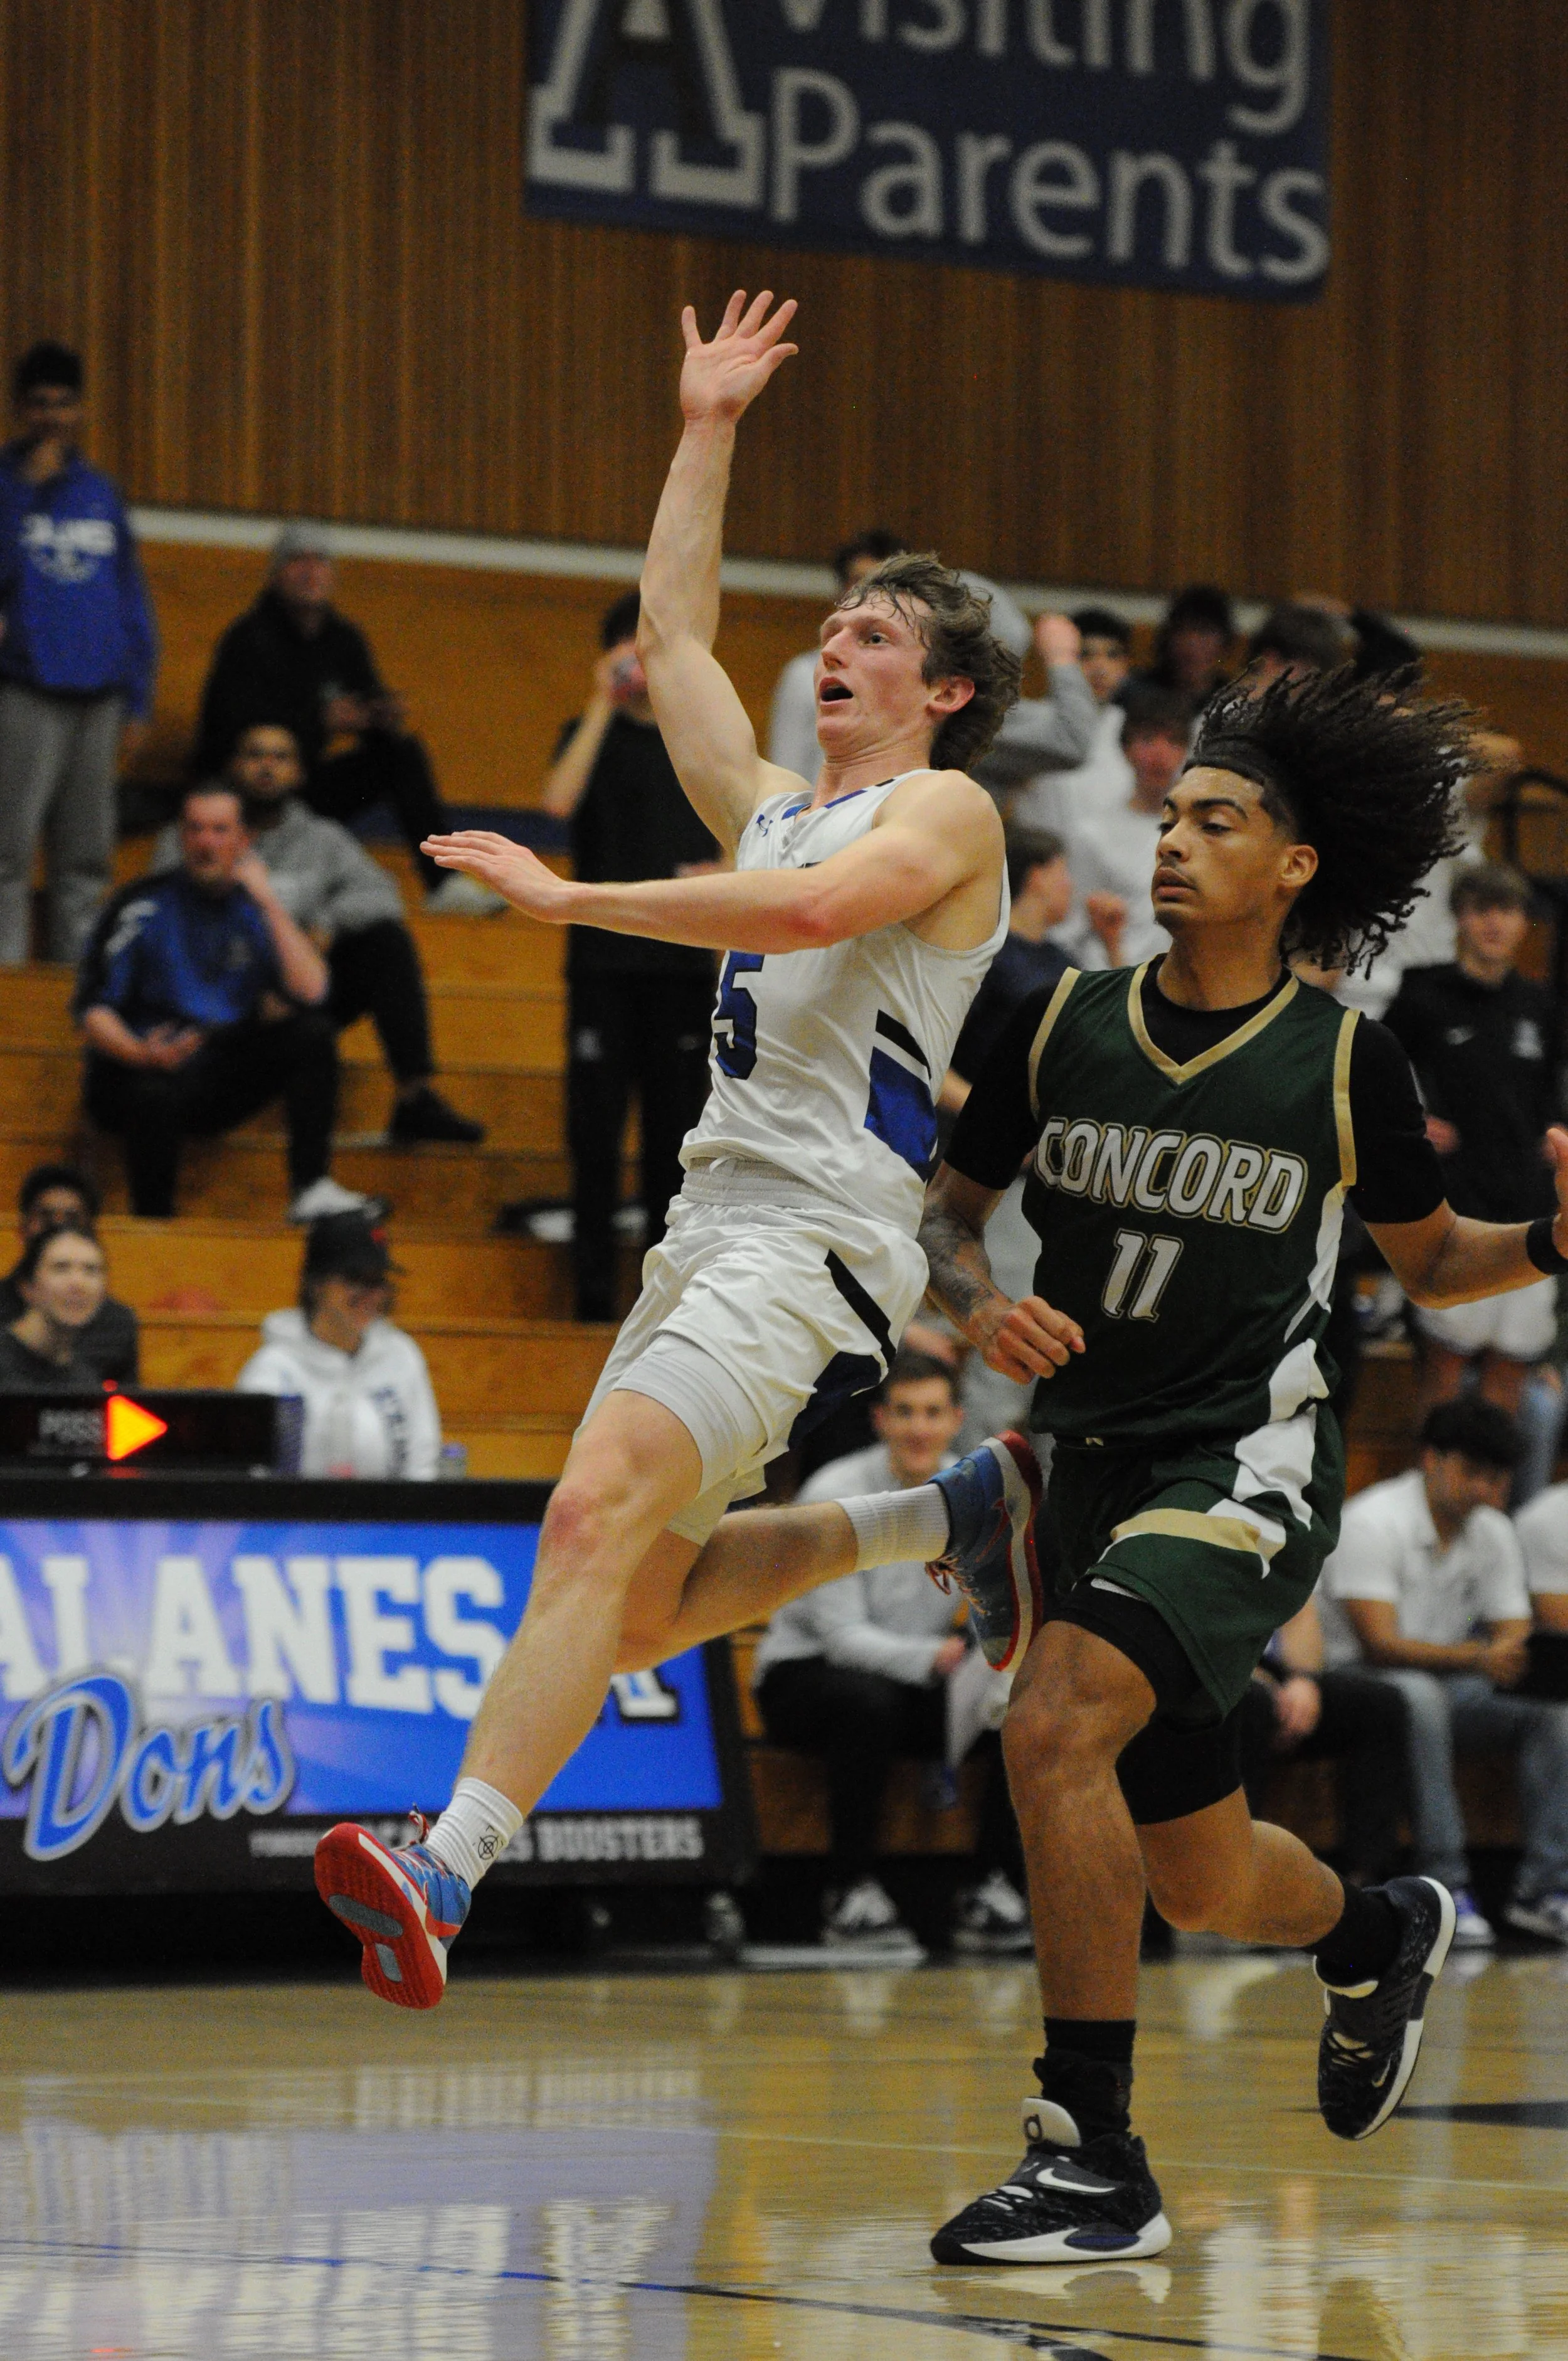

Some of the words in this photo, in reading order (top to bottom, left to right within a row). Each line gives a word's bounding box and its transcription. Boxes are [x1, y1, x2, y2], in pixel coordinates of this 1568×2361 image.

[771, 66, 1332, 283] Parents
[712, 949, 765, 1081] 5
[1035, 1116, 1309, 1234] CONCORD
[1101, 1228, 1184, 1323] 11
[4, 1661, 295, 1862] Dons
